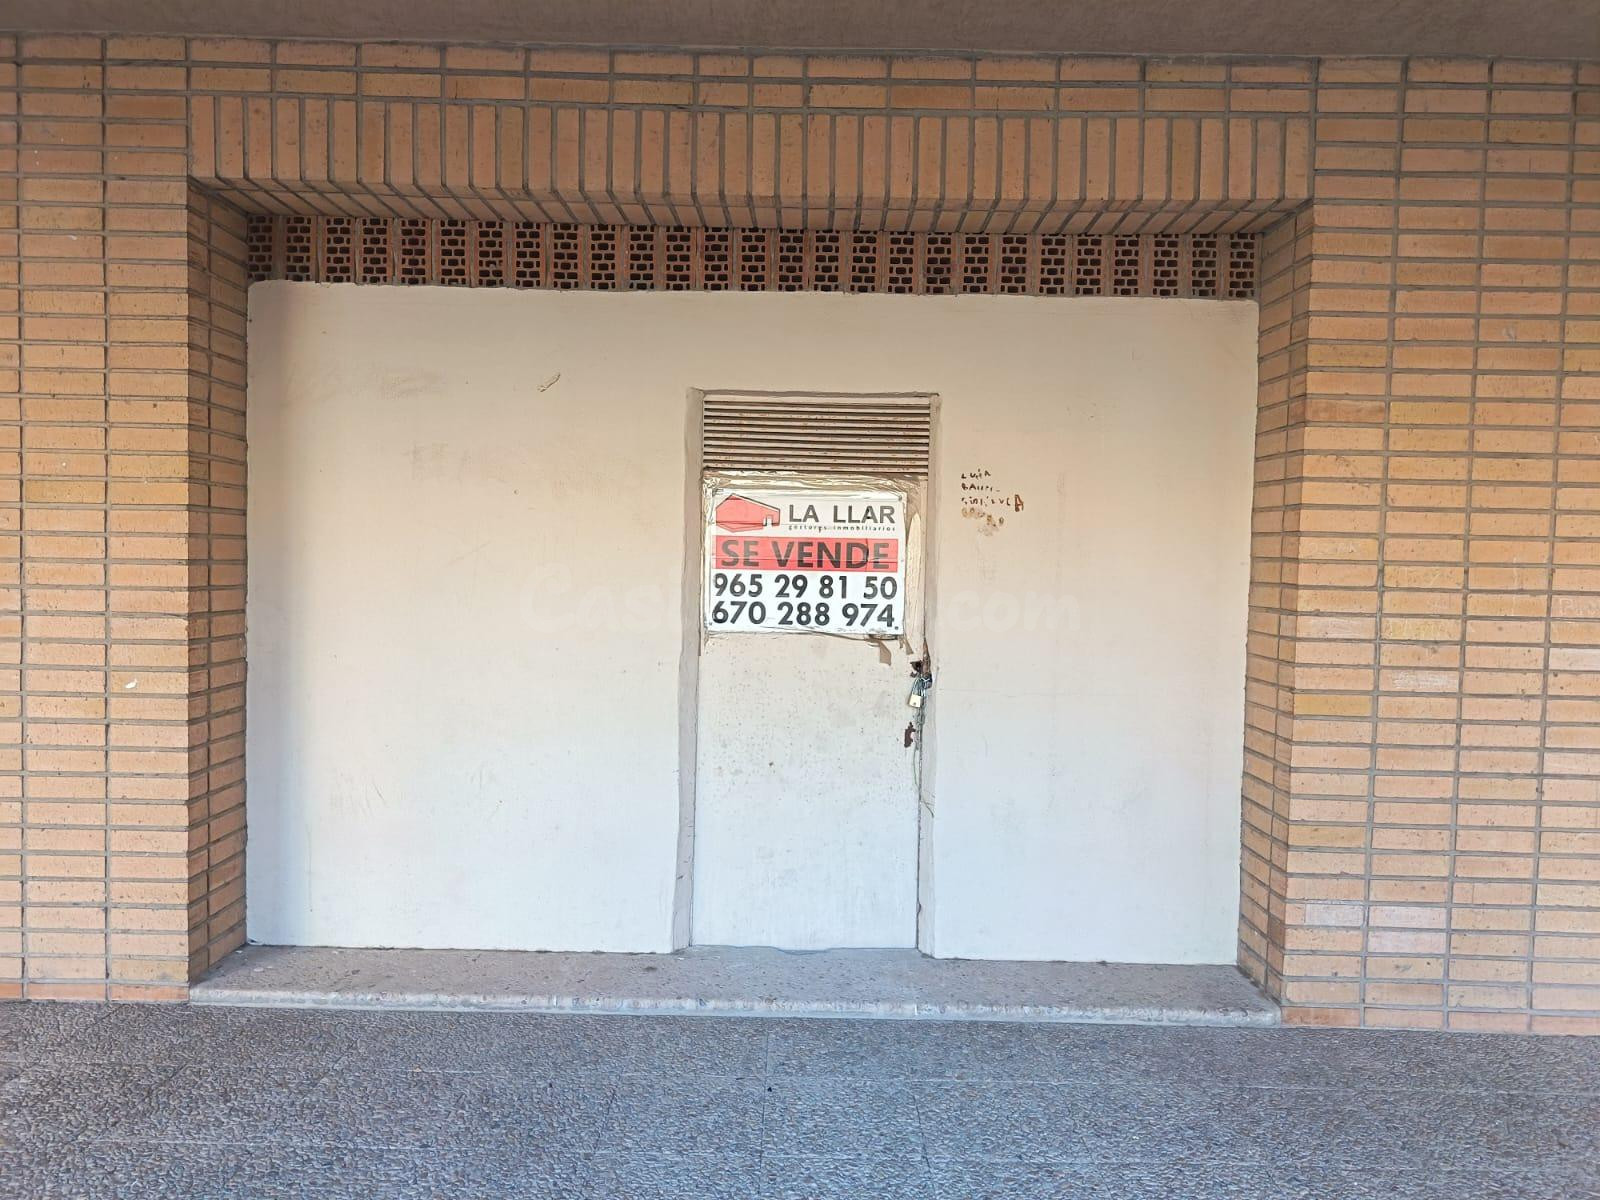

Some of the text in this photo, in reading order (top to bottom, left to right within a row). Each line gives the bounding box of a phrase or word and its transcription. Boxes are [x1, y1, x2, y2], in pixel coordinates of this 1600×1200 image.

[789, 504, 896, 524] LA LLAR
[721, 539, 890, 569] SE VENDE
[714, 572, 898, 600] 965 29 81 50
[712, 601, 895, 627] 670 288 974
